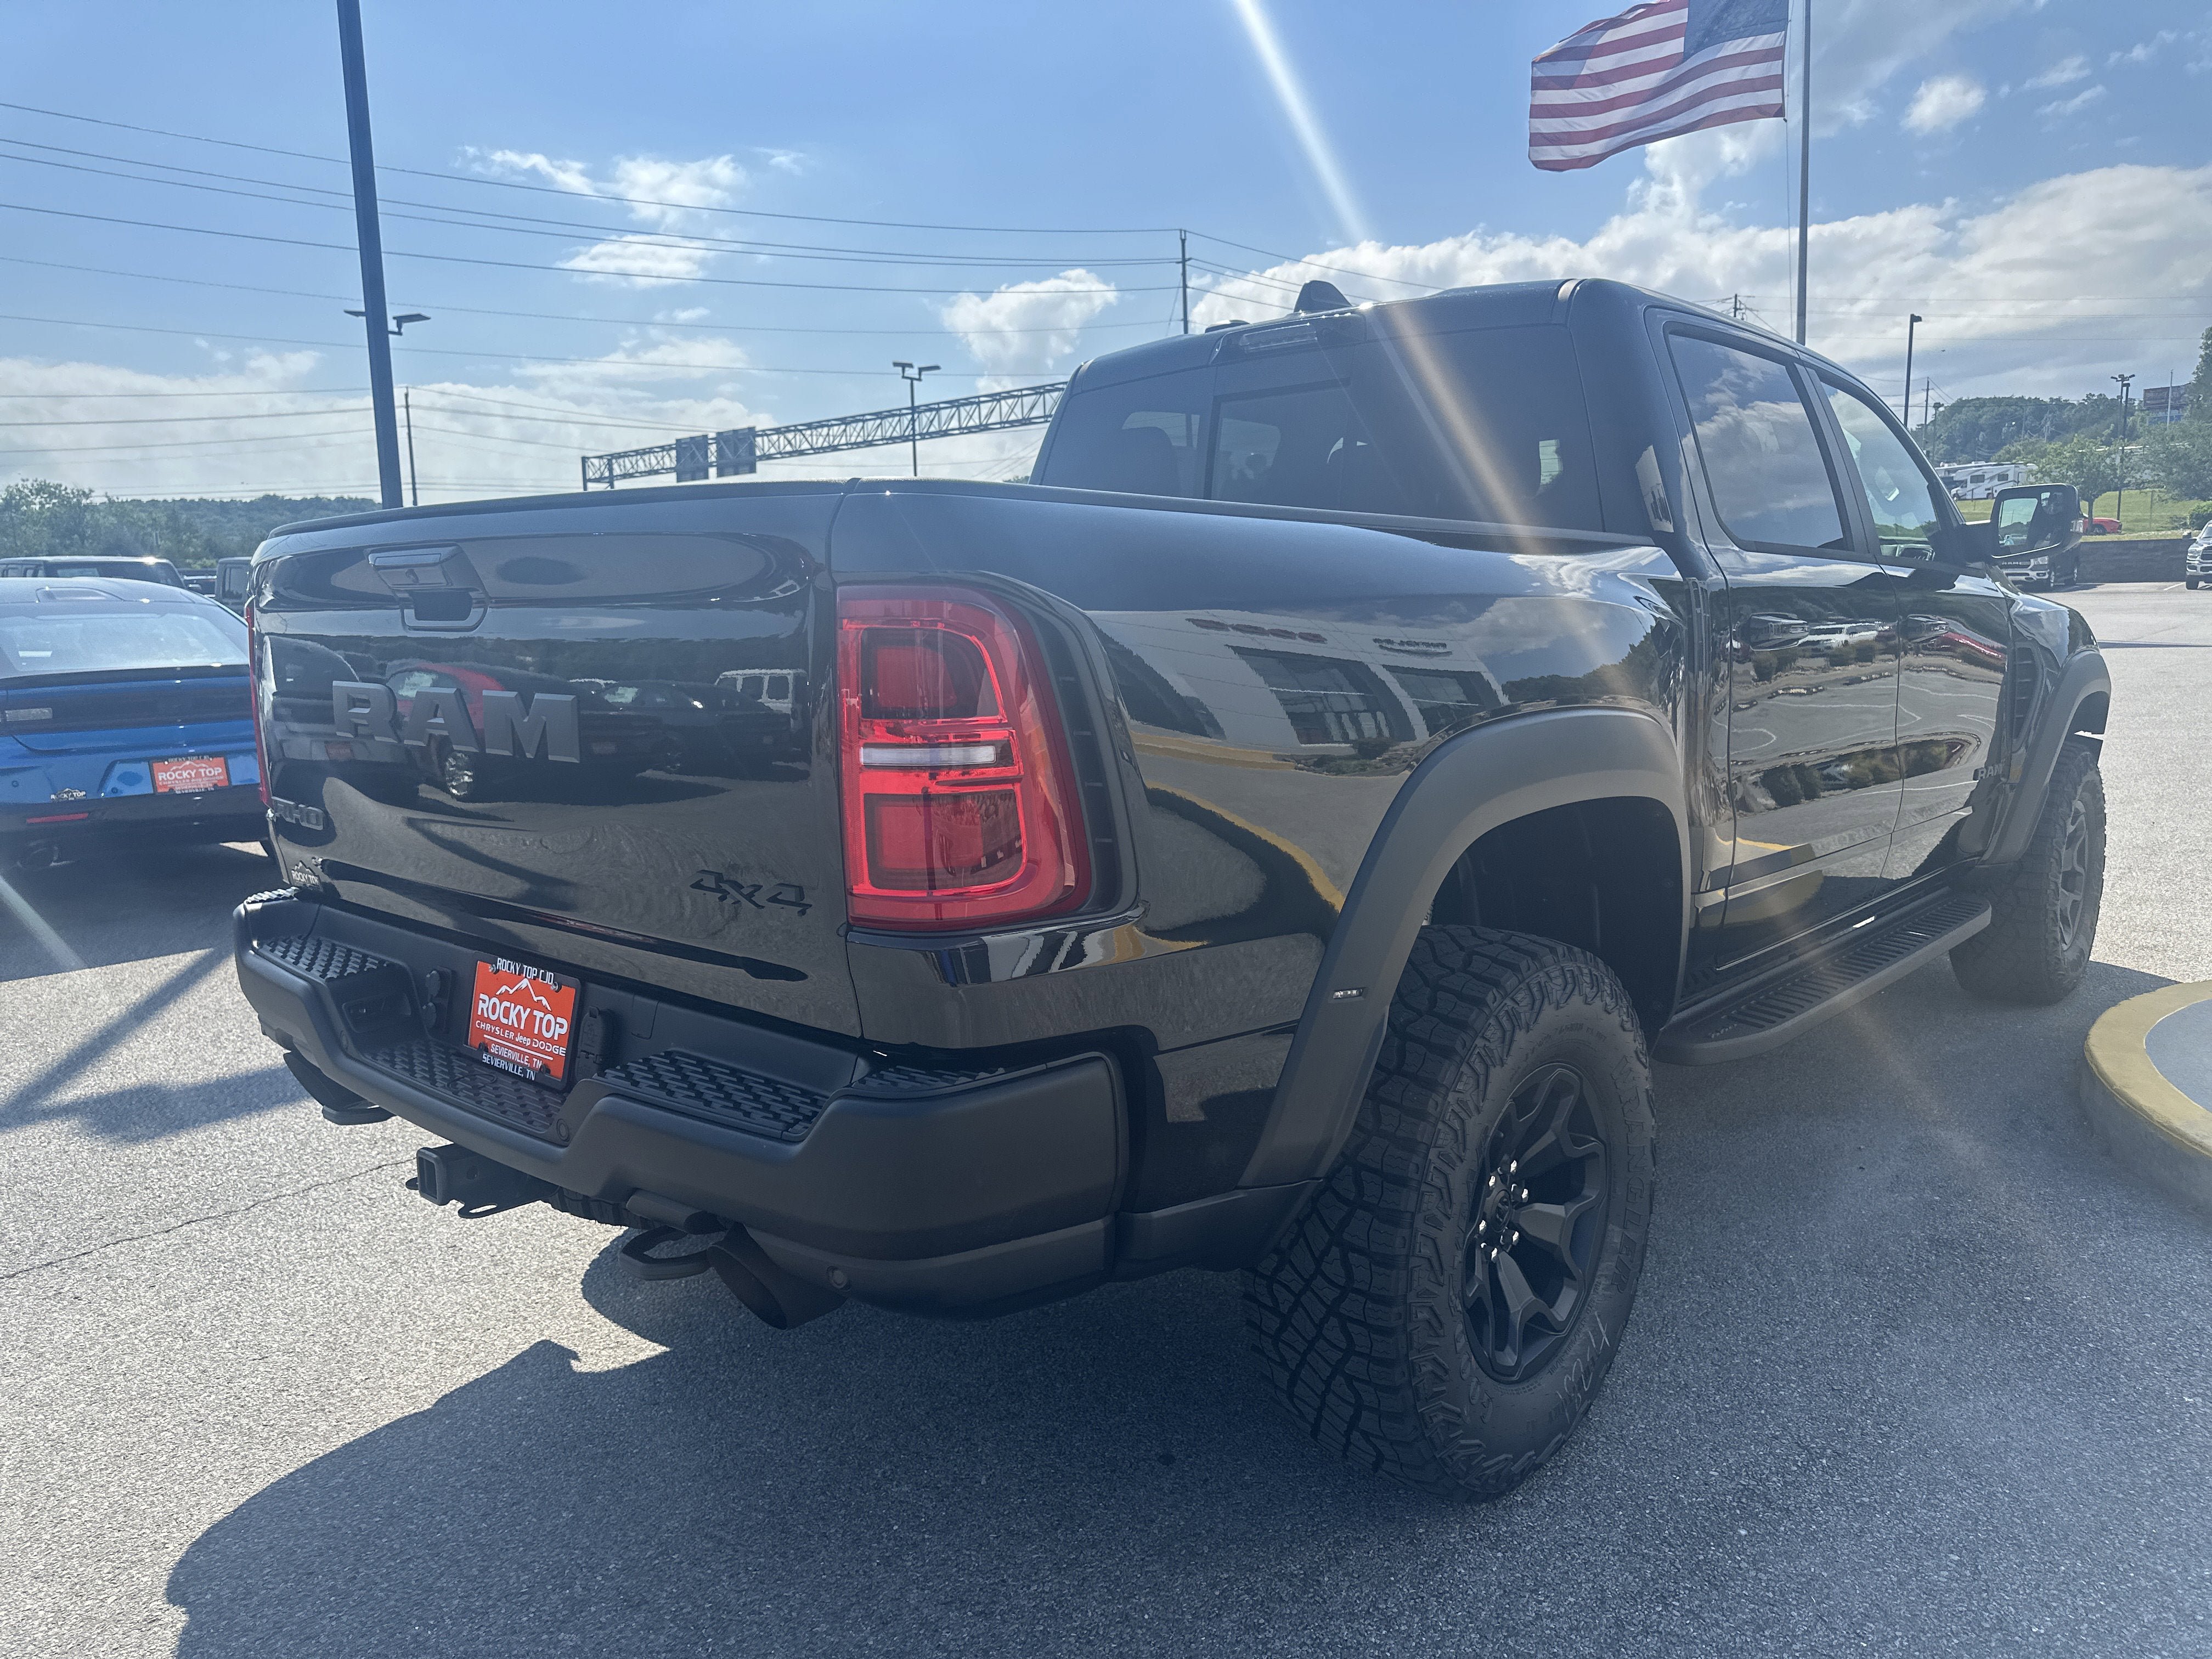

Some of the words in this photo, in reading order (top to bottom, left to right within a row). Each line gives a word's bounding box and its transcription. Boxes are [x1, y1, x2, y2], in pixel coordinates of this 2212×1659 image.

[332, 680, 580, 763] RAM
[158, 769, 196, 781] ROCKY
[198, 767, 223, 777] TOP
[1978, 763, 2004, 780] RAM
[272, 796, 324, 831] RHO
[496, 957, 521, 977] ROCKY
[522, 965, 538, 980] TOP
[539, 969, 554, 985] CJD
[477, 992, 531, 1030] ROCKY
[533, 1009, 568, 1041] TOP
[475, 1020, 515, 1041] CHRYSLER
[515, 1032, 531, 1047] Jeep
[532, 1038, 567, 1057] DODGE
[482, 1053, 524, 1078] SEVIERVILLE,
[526, 1069, 537, 1081] TN
[490, 1043, 531, 1068] SEVIERVILLE,
[532, 1058, 543, 1069] TN
[1611, 1054, 1647, 1295] WRANGLER
